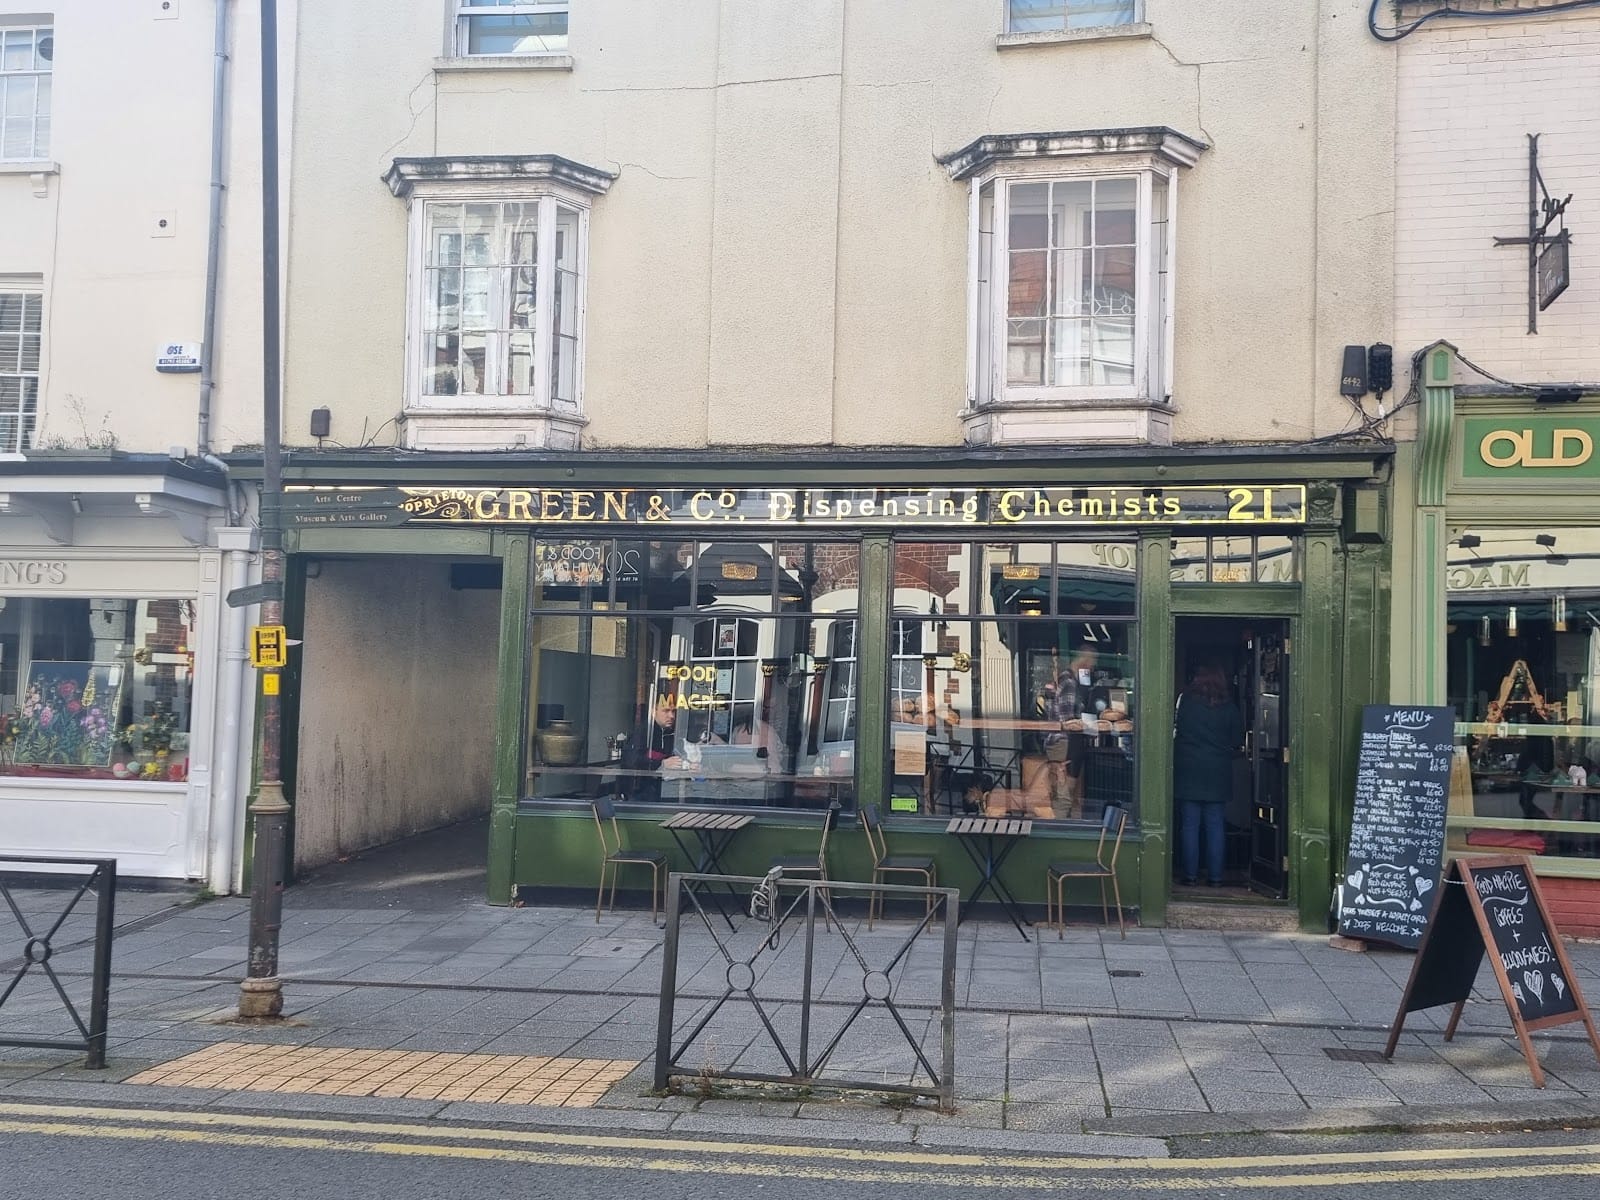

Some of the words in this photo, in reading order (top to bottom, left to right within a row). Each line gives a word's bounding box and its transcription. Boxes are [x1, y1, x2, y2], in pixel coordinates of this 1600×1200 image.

[1480, 429, 1593, 468] OLD
[314, 495, 331, 503] Arts
[337, 494, 362, 502] Centre
[398, 489, 474, 512] OPRIETOR
[475, 490, 629, 520] GREEN
[646, 495, 671, 521] &
[768, 491, 978, 521] Dispensing
[998, 490, 1181, 520] Chemists
[1227, 488, 1272, 520] 21
[295, 515, 327, 523] Museum
[359, 513, 387, 522] Gallery
[667, 665, 718, 682] FOOD
[1393, 711, 1424, 724] MENU
